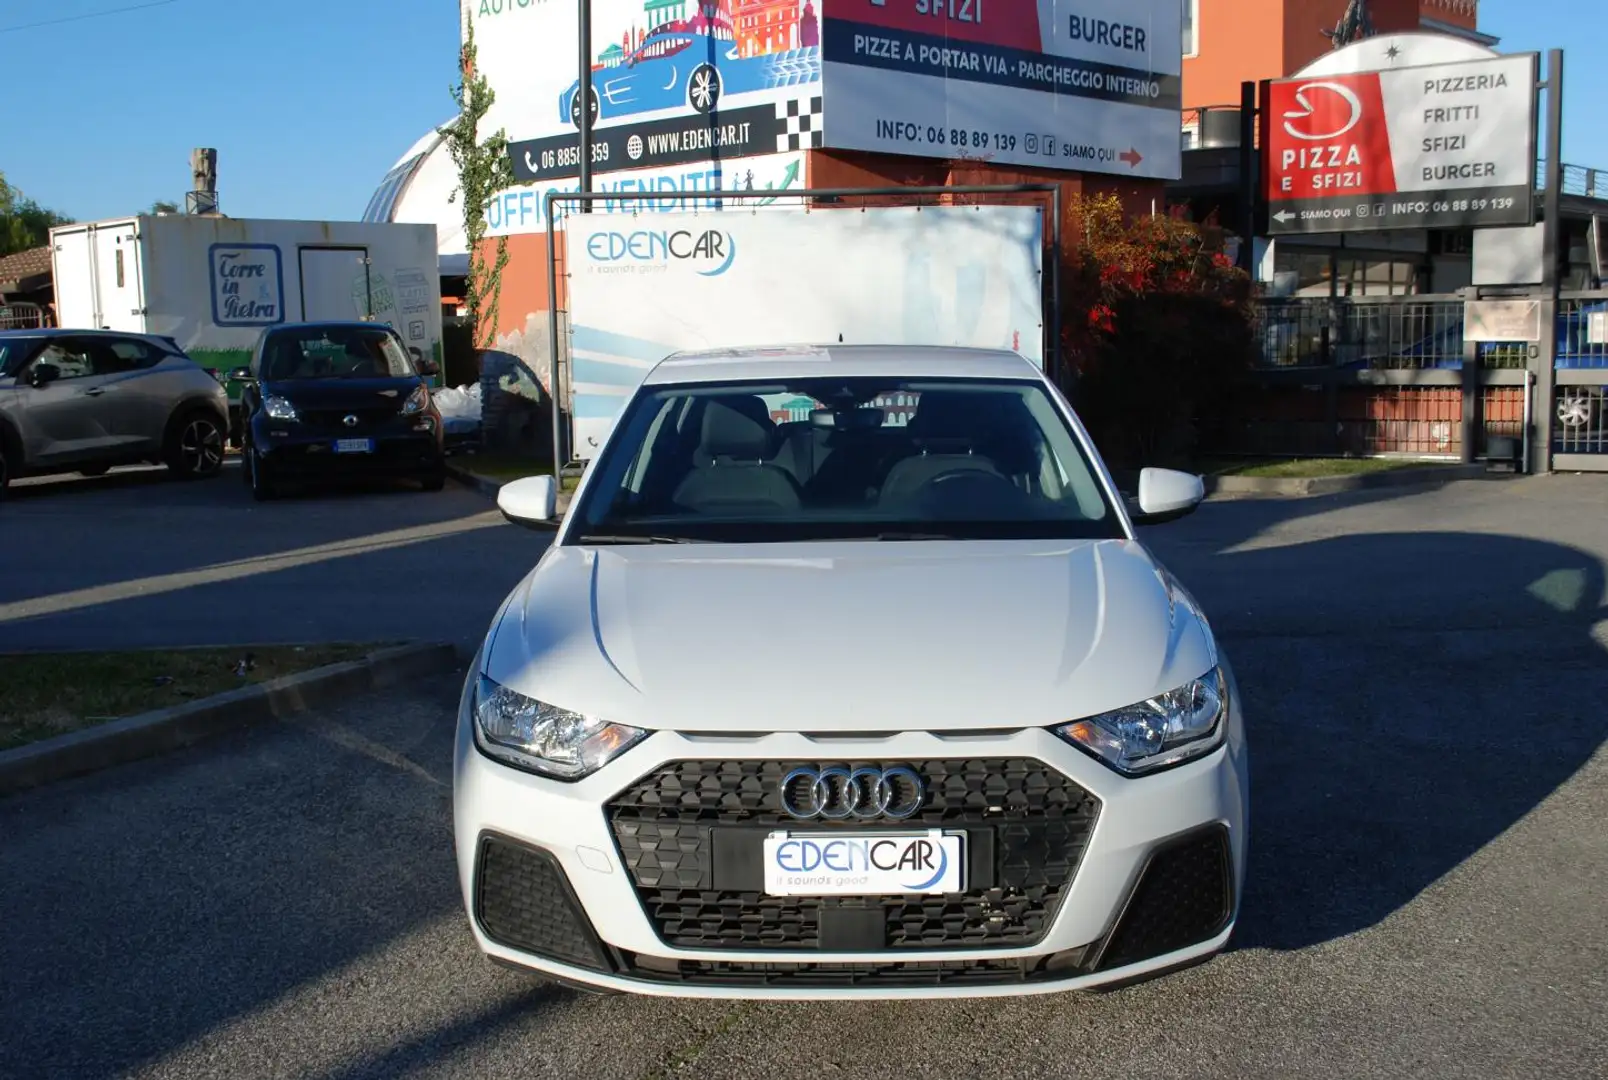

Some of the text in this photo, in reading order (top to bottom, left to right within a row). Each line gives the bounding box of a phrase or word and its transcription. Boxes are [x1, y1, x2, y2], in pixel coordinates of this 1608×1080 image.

[1069, 14, 1146, 52] BURGER
[854, 34, 1160, 98] PIZZE A PORTAR VIA PARCHEGGIO INTERNO
[1423, 73, 1508, 94] PIZZERIA
[1423, 104, 1479, 123] FRITTI
[647, 123, 751, 155] WWW.EDENCAR.IT
[876, 119, 1115, 162] INFO: 06 88 89 139 SIAMO QUI
[1421, 134, 1466, 152] SFIZI
[541, 150, 555, 169] 06
[1282, 143, 1361, 170] PIZZA
[1282, 171, 1362, 191] E SFIZI
[1422, 162, 1496, 181] BURGER
[601, 169, 723, 216] VENDITE
[1300, 197, 1513, 220] SIAMO QUI INFO: 06 88 89 139
[587, 230, 725, 261] EDENCAR
[219, 253, 265, 278] Torre
[222, 279, 239, 295] in
[776, 840, 935, 872] EDENCAR
[786, 875, 832, 886] sounds
[835, 875, 869, 888] good
